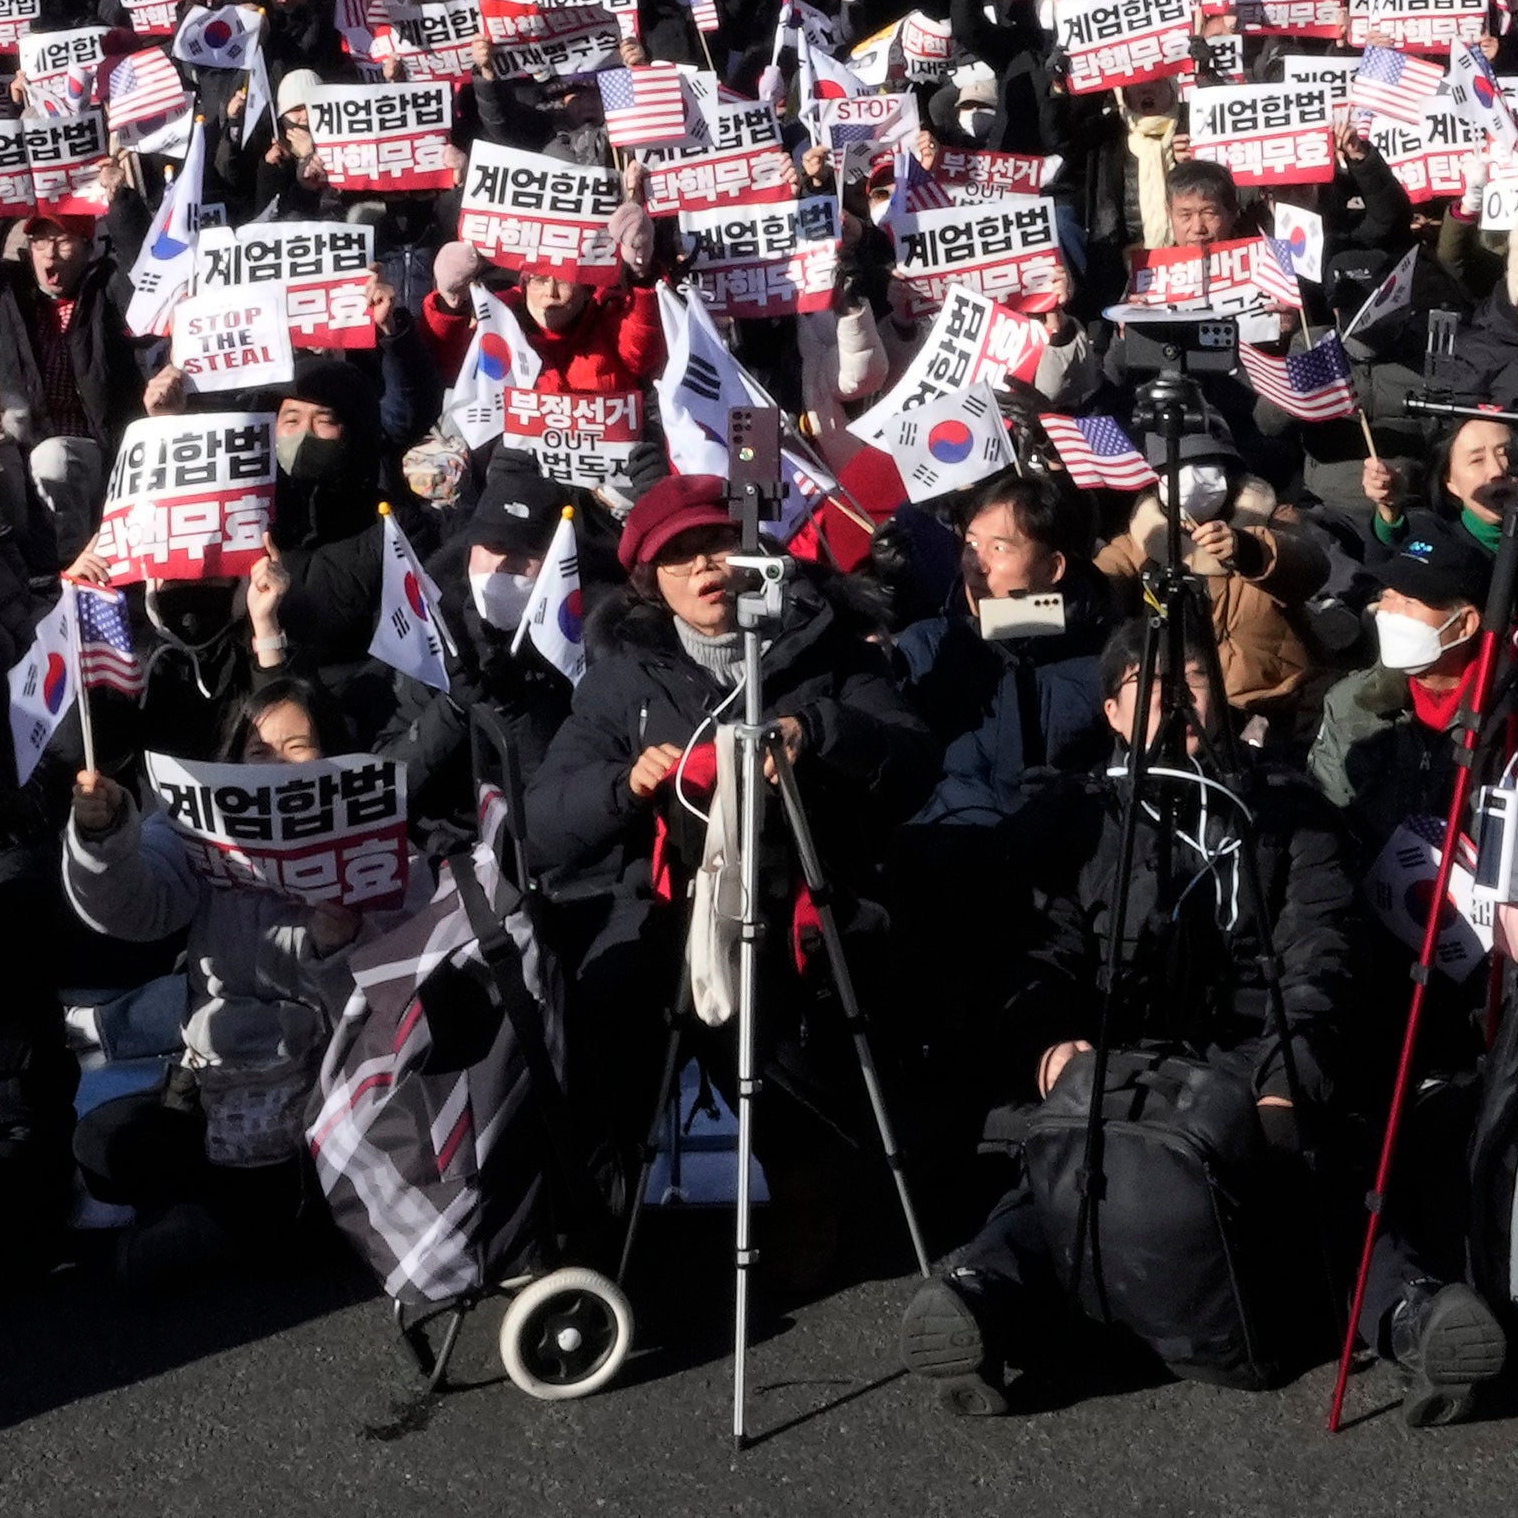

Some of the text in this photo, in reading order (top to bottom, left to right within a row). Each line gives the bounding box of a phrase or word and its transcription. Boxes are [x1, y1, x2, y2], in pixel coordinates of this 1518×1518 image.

[1072, 35, 1191, 88] 탄핵무효
[312, 89, 445, 135] 계엄합법
[320, 135, 448, 184] 탄핵무효
[941, 152, 1038, 186] 부정선거
[472, 162, 623, 215] 계엄합법
[204, 230, 370, 285] 계엄합법
[462, 215, 617, 267] 탄핵무효
[902, 205, 1050, 268] 계엄합법
[189, 307, 262, 335] STOP
[508, 390, 638, 430] 부정선거
[544, 432, 600, 450] OUT
[97, 495, 270, 574] 탄핵무효
[160, 761, 398, 844] 계엄합법
